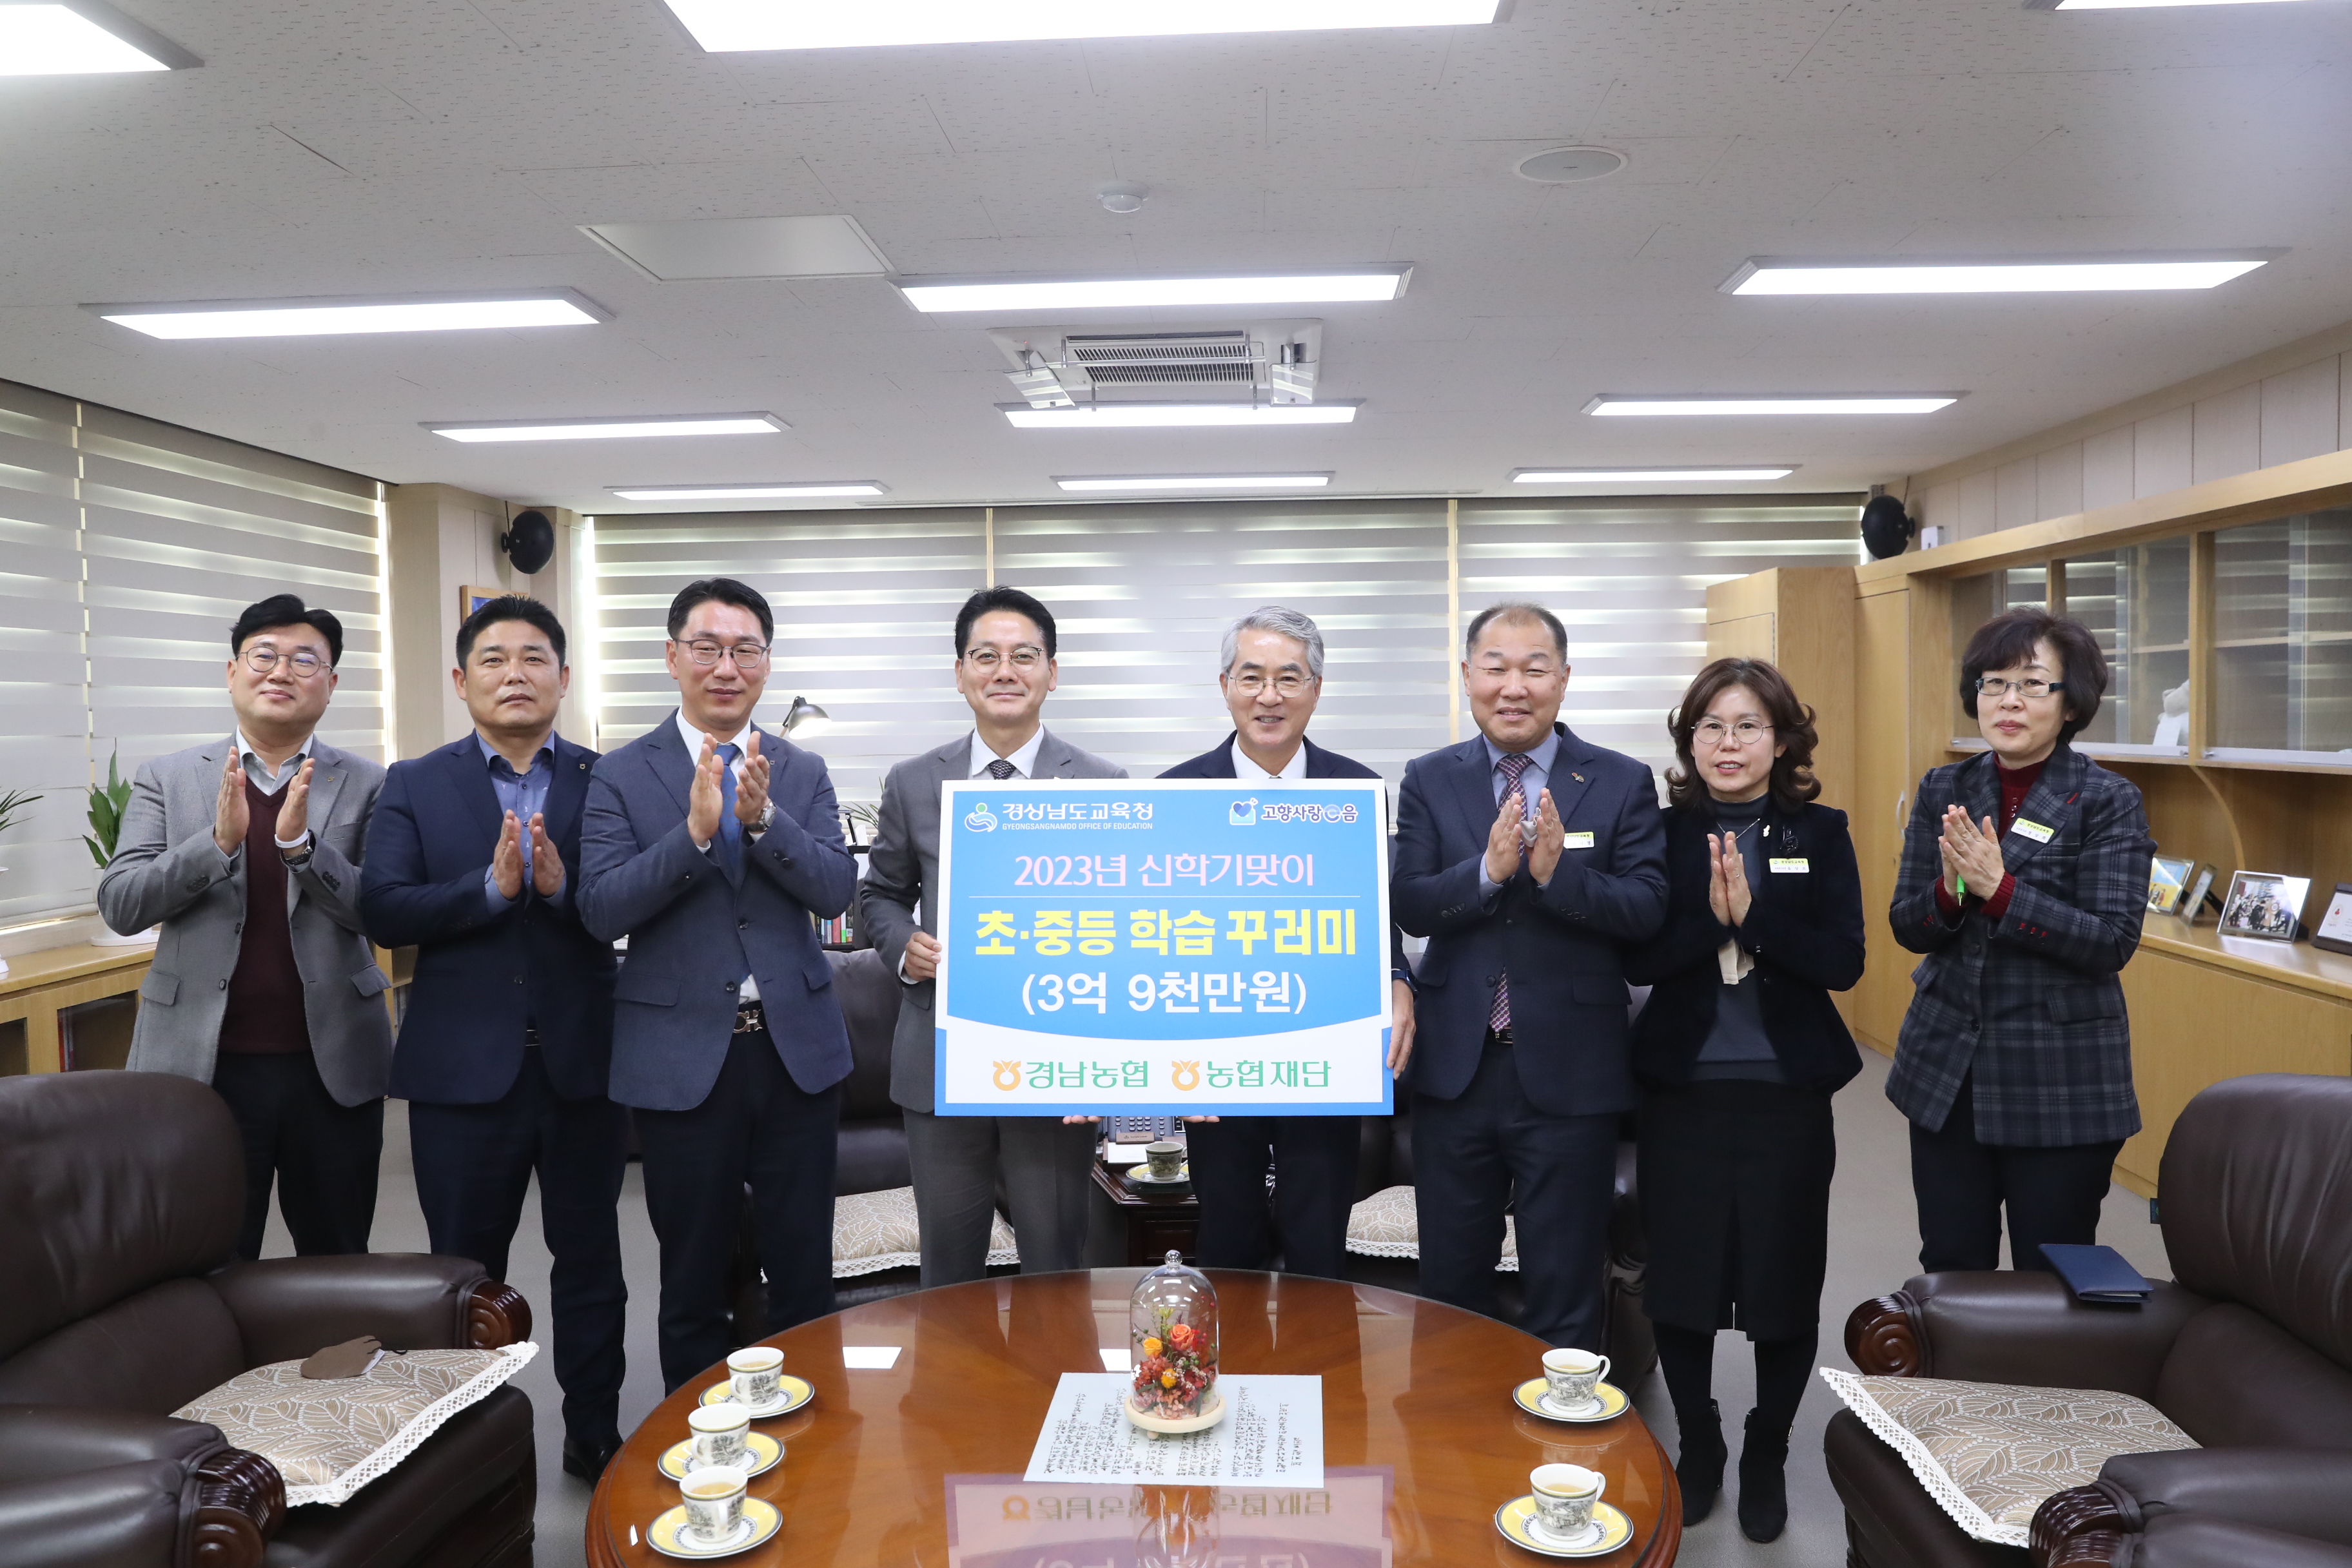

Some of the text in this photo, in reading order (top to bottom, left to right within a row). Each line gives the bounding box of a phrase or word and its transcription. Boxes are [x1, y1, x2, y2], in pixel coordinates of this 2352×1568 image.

[1002, 801, 1153, 821] 경상남도교육청
[1002, 822, 1153, 831] GYEONGSANGNAMDO OFFICE OF EDUCATION
[1262, 804, 1358, 823] 고향사랑e음
[1014, 852, 1315, 887] 2023년 신학기맞이
[975, 908, 1356, 957] 초·중등 학습 꾸러미
[1021, 970, 1308, 1016] (3억 9천만원)
[1026, 1059, 1149, 1090] 경남농협
